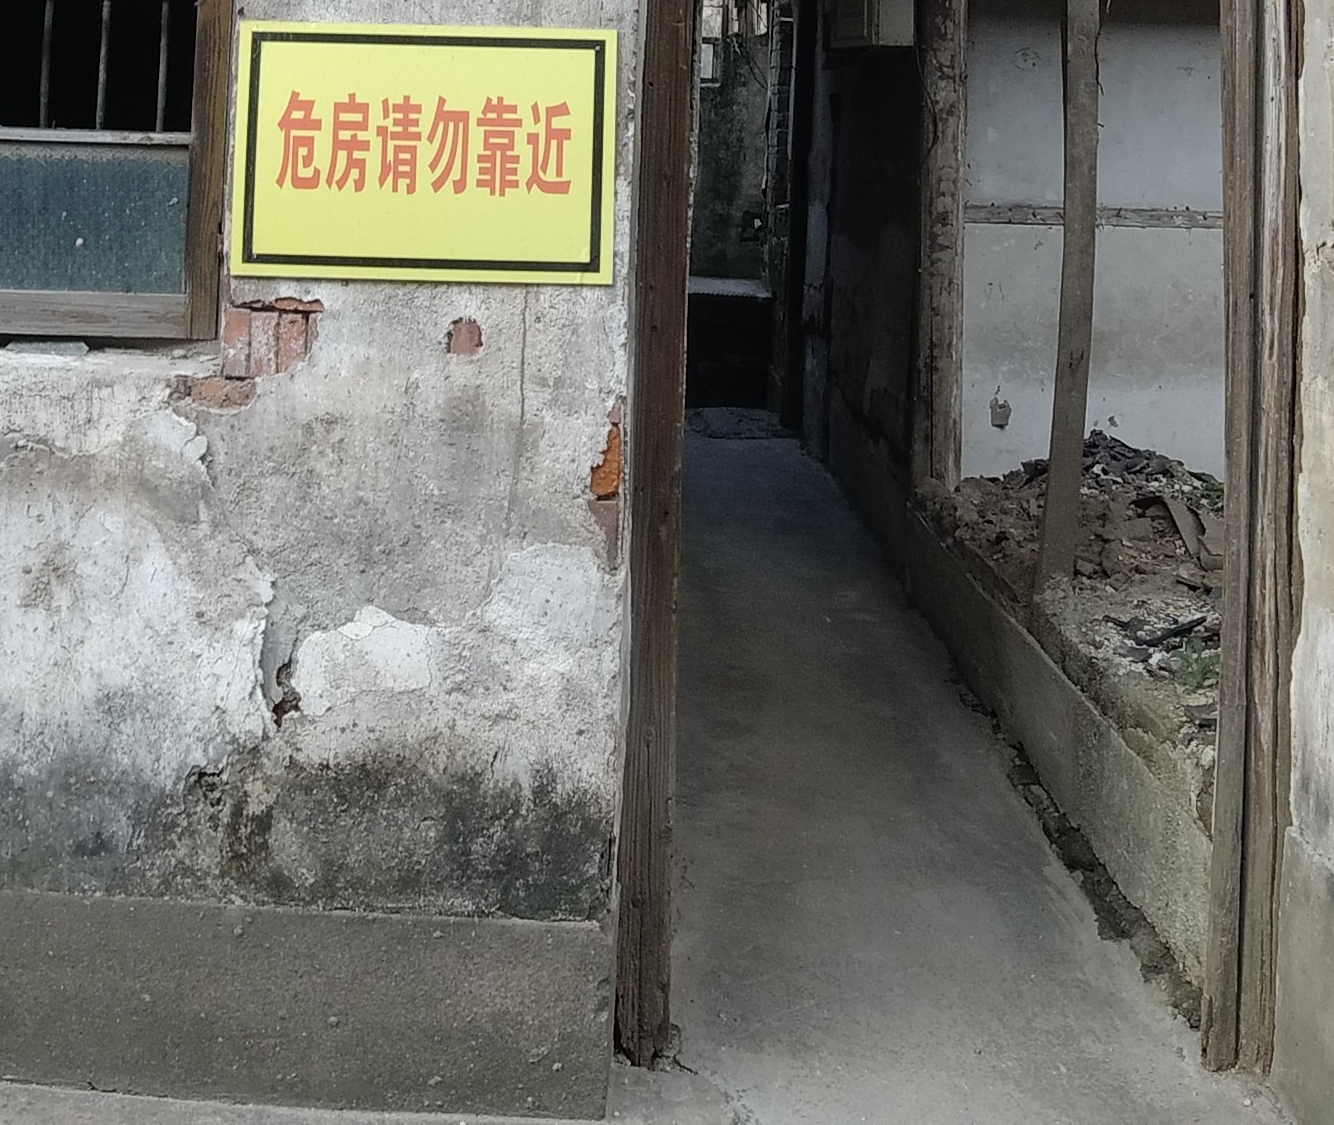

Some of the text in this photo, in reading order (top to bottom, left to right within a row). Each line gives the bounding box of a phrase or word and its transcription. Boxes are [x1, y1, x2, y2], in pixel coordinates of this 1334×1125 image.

[275, 90, 573, 197] 危房请勿靠近
